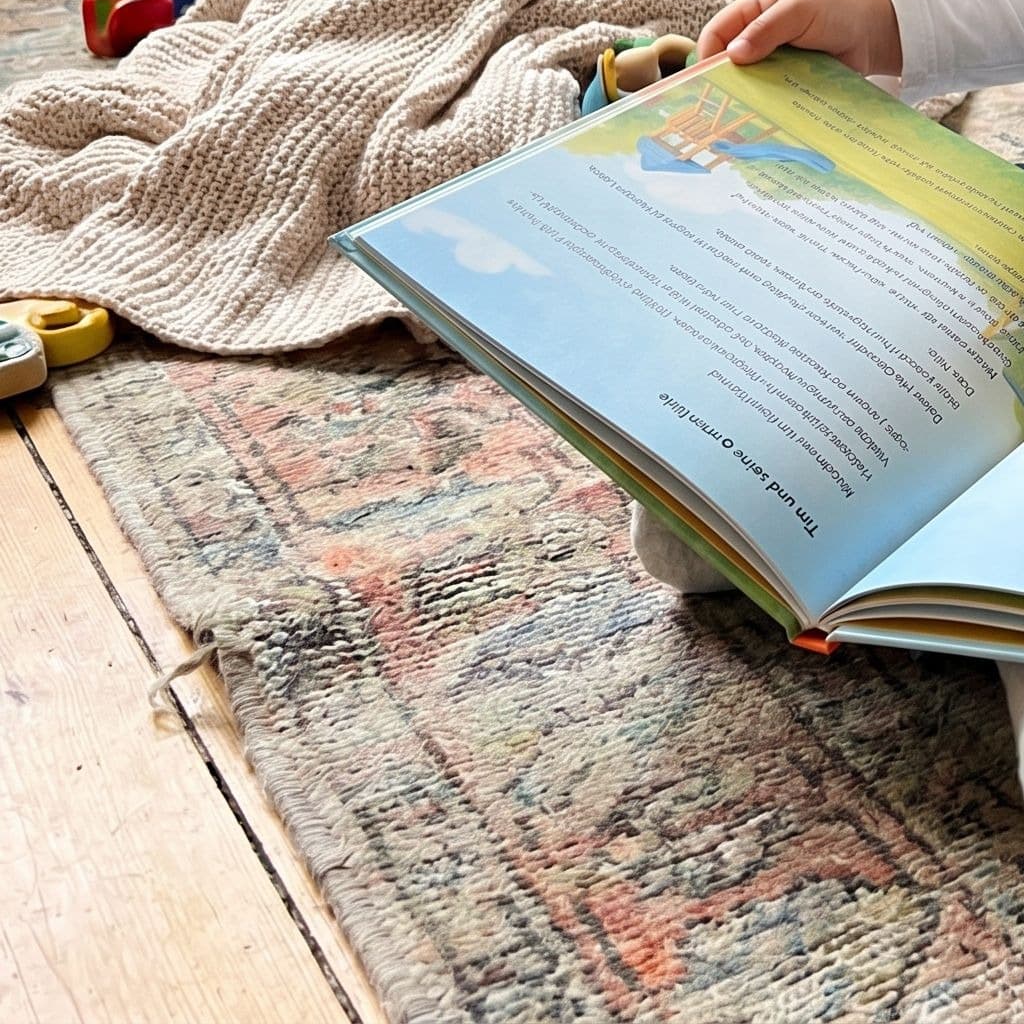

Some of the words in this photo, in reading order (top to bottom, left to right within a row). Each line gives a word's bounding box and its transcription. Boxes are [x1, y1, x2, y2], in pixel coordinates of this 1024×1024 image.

[733, 449, 770, 482] seine
[765, 481, 796, 507] und
[795, 507, 819, 538] Tim
